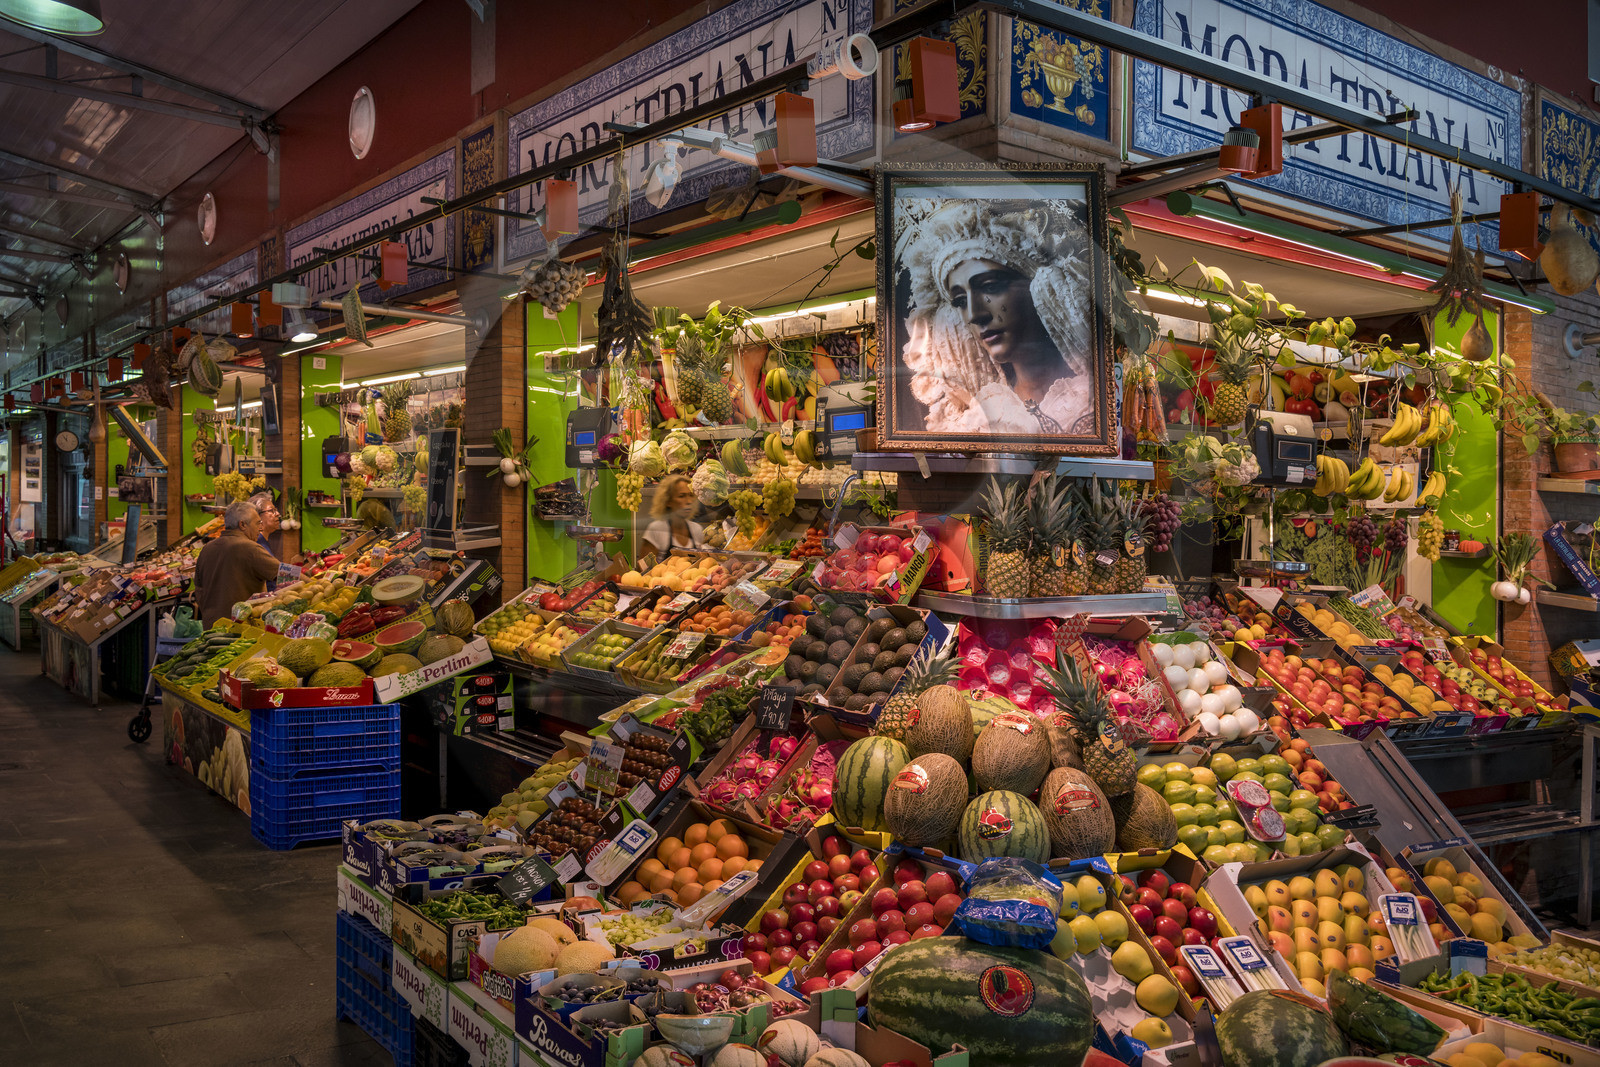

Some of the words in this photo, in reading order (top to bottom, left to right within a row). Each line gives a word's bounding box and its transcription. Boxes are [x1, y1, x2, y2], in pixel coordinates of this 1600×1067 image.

[526, 109, 628, 214] MORA
[634, 28, 810, 173] TRIANA
[1329, 65, 1480, 206] TRIANA
[902, 553, 926, 587] MANGO
[423, 655, 472, 682] Perlim
[476, 677, 494, 685] TROPS
[477, 696, 495, 705] TROPS
[478, 714, 496, 723] TROPS
[660, 766, 681, 791] TROPS
[349, 883, 380, 925] Perlim
[457, 925, 479, 938] CASI
[395, 959, 425, 1004] Perlim
[452, 1004, 488, 1057] Perlim
